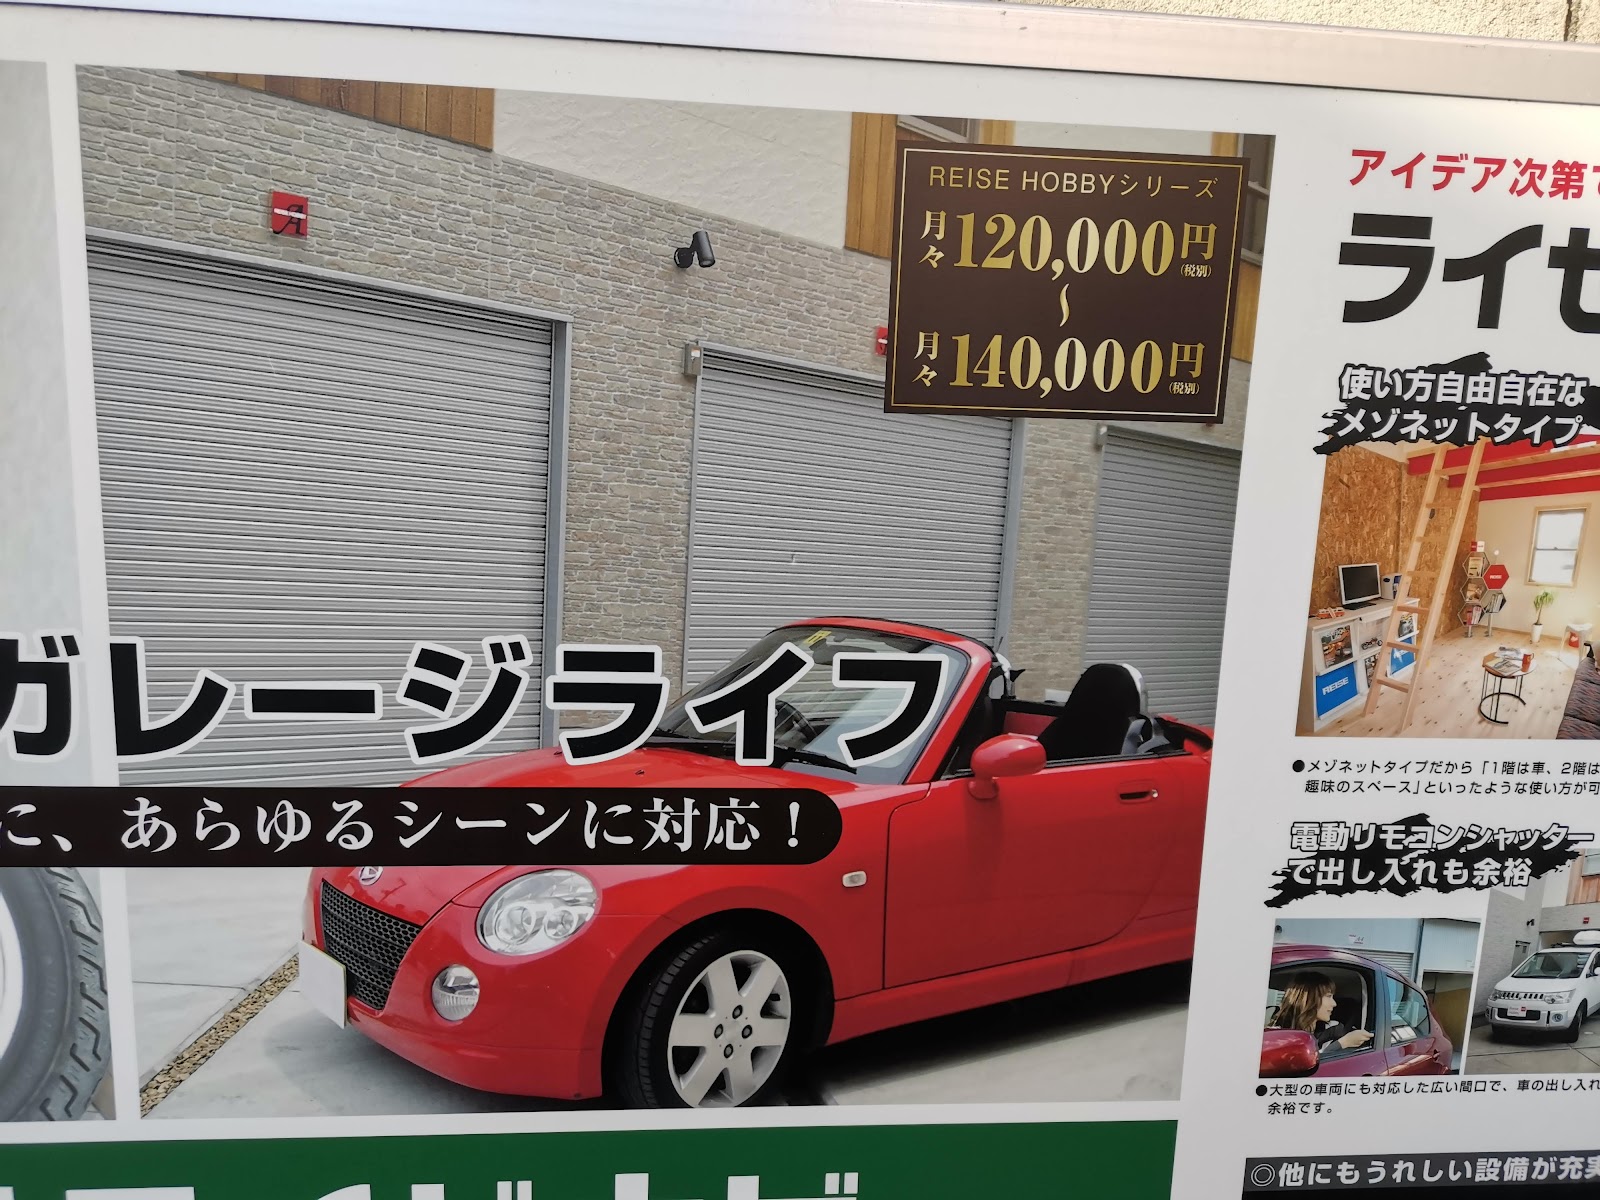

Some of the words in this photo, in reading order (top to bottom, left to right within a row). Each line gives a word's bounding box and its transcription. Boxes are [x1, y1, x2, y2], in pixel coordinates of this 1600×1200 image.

[929, 165, 1010, 190] REISE
[1022, 171, 1218, 199] HOBBYシリーズ
[1349, 149, 1600, 200] アイデア次第
[1341, 367, 1586, 406] 使い方自由自在な
[1337, 408, 1584, 444] メゾネットタイプ
[0, 634, 946, 763] ガレージライフ
[1291, 822, 1594, 850] 電動リモコンシャッター
[1288, 856, 1533, 887] で出し入れも余裕
[1267, 1102, 1334, 1115] 余裕です。
